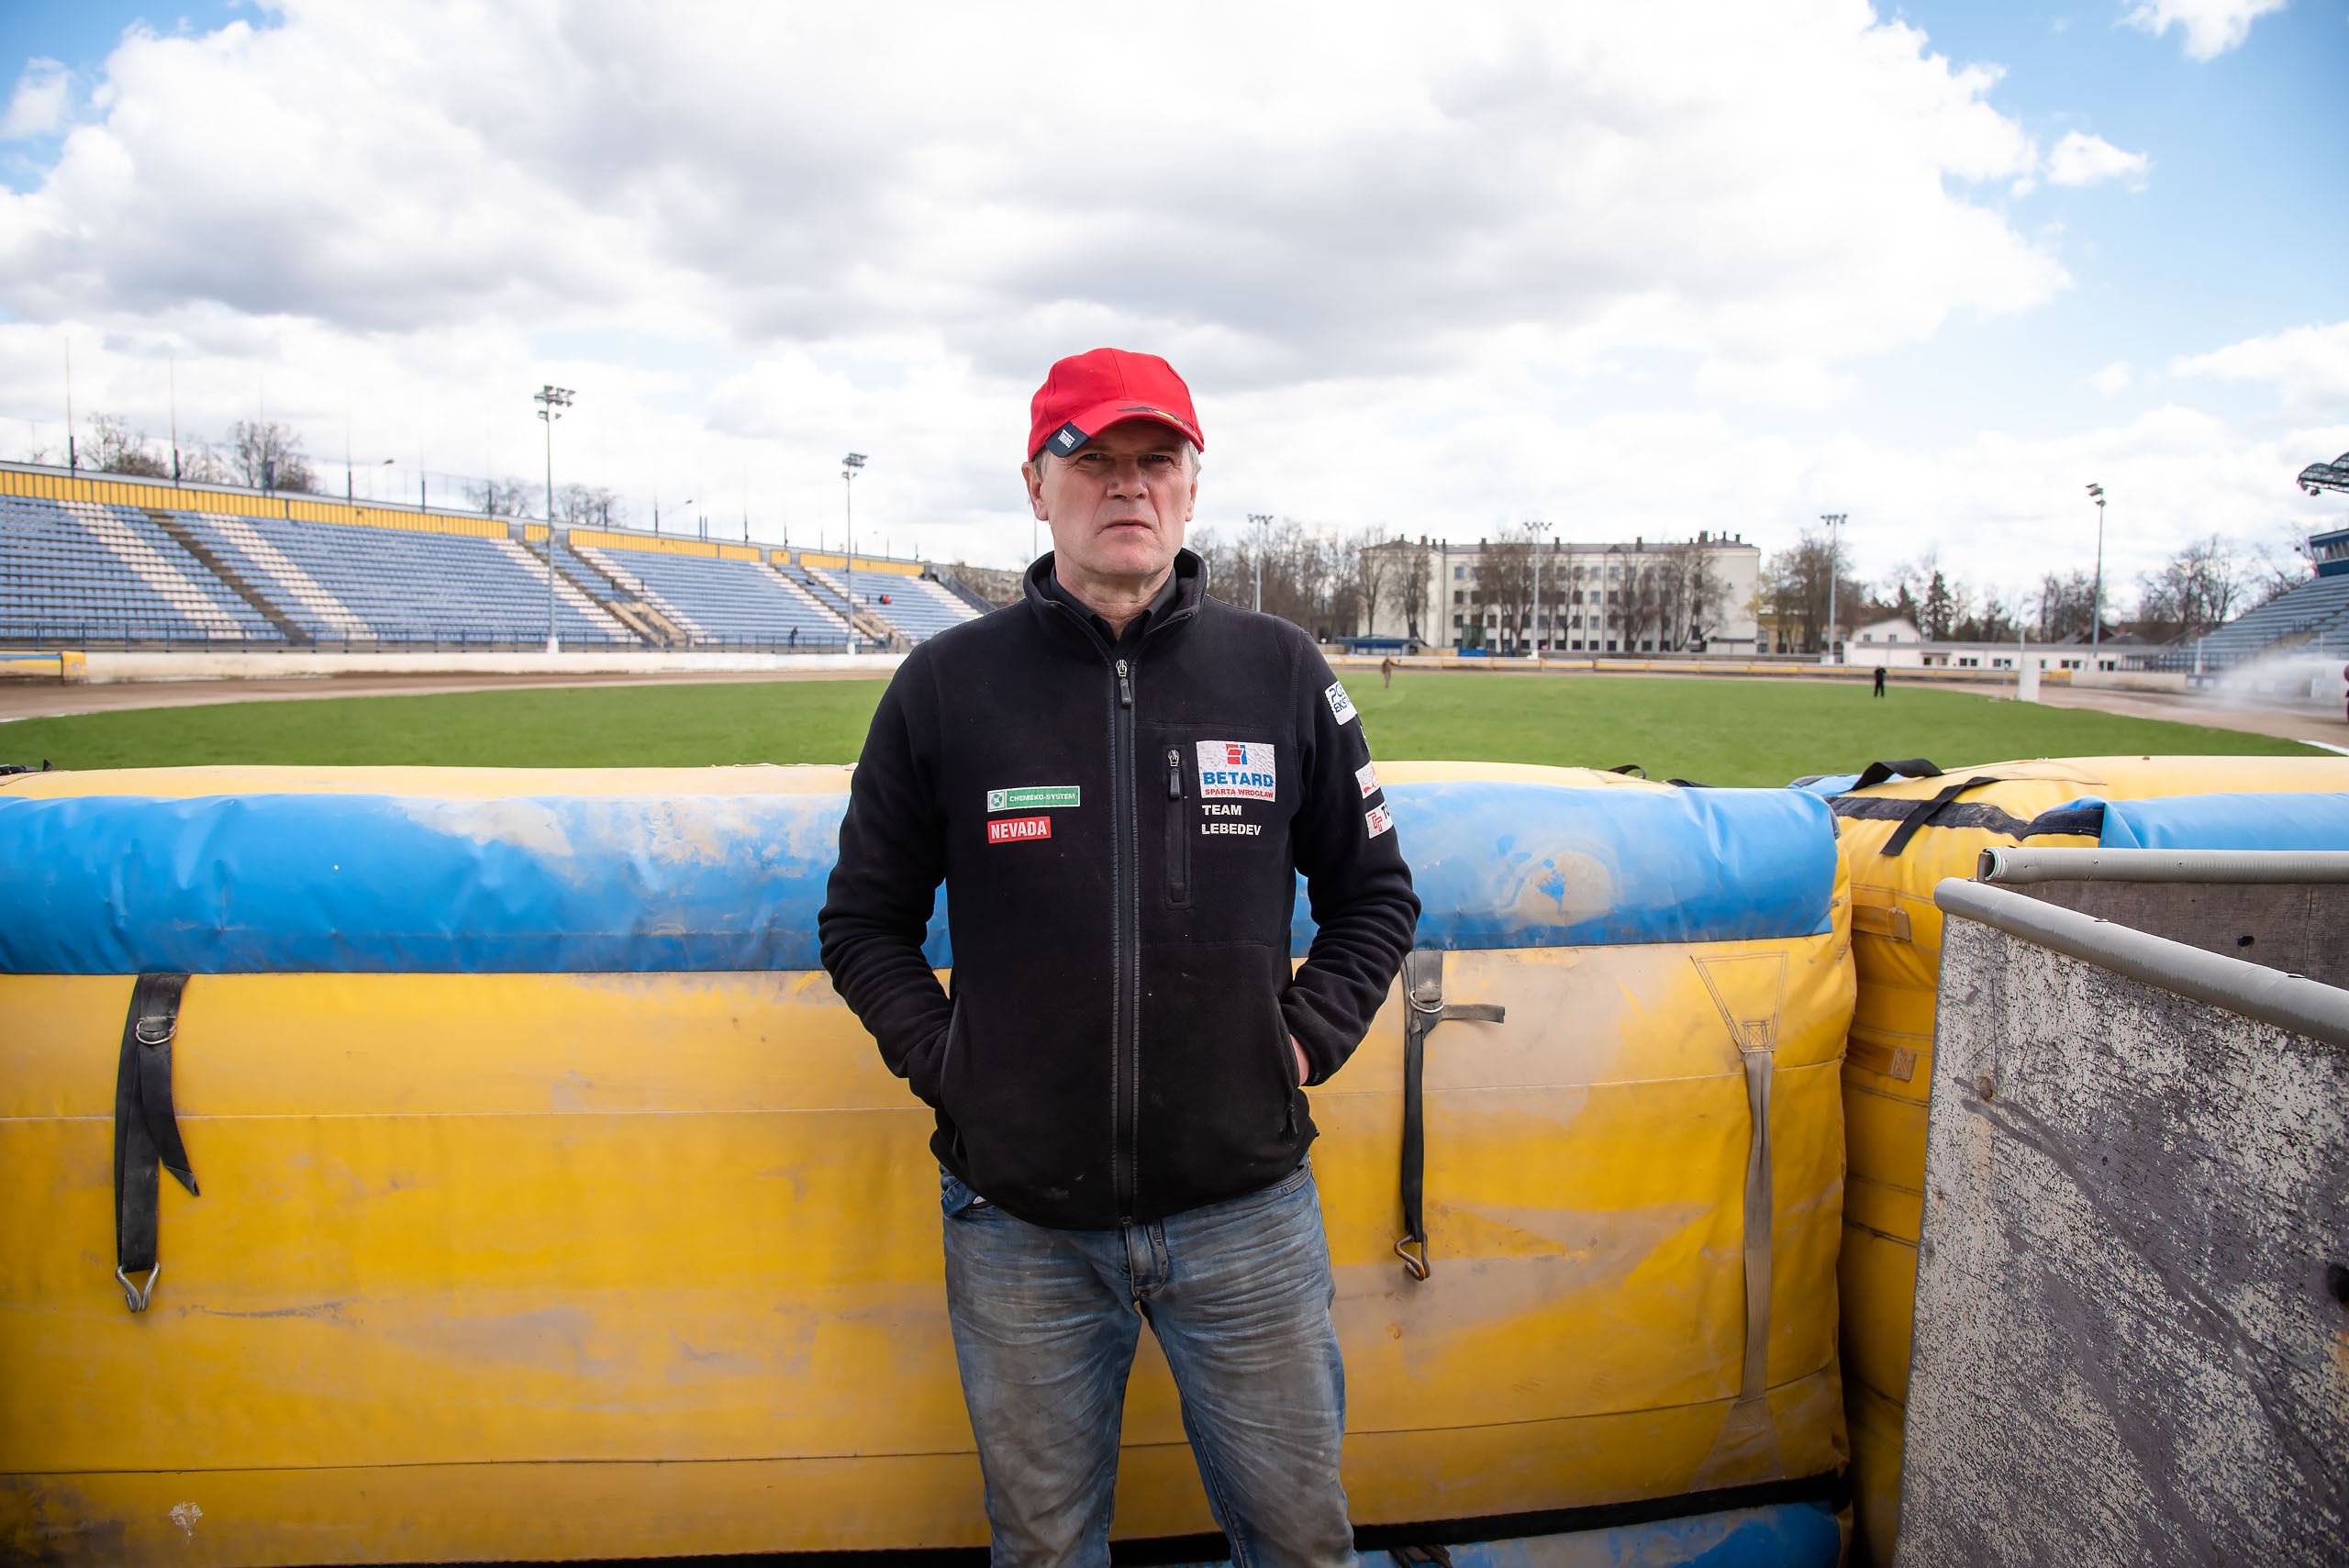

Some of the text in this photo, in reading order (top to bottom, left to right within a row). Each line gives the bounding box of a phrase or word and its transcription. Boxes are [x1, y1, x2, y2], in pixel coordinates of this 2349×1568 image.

[1203, 772, 1274, 787] BETARD
[1009, 794, 1075, 802] CHEMEKO-SYSTEM
[1201, 805, 1242, 816] TEAM
[991, 821, 1047, 839] NEVADA
[1201, 823, 1262, 836] LEBEDEV
